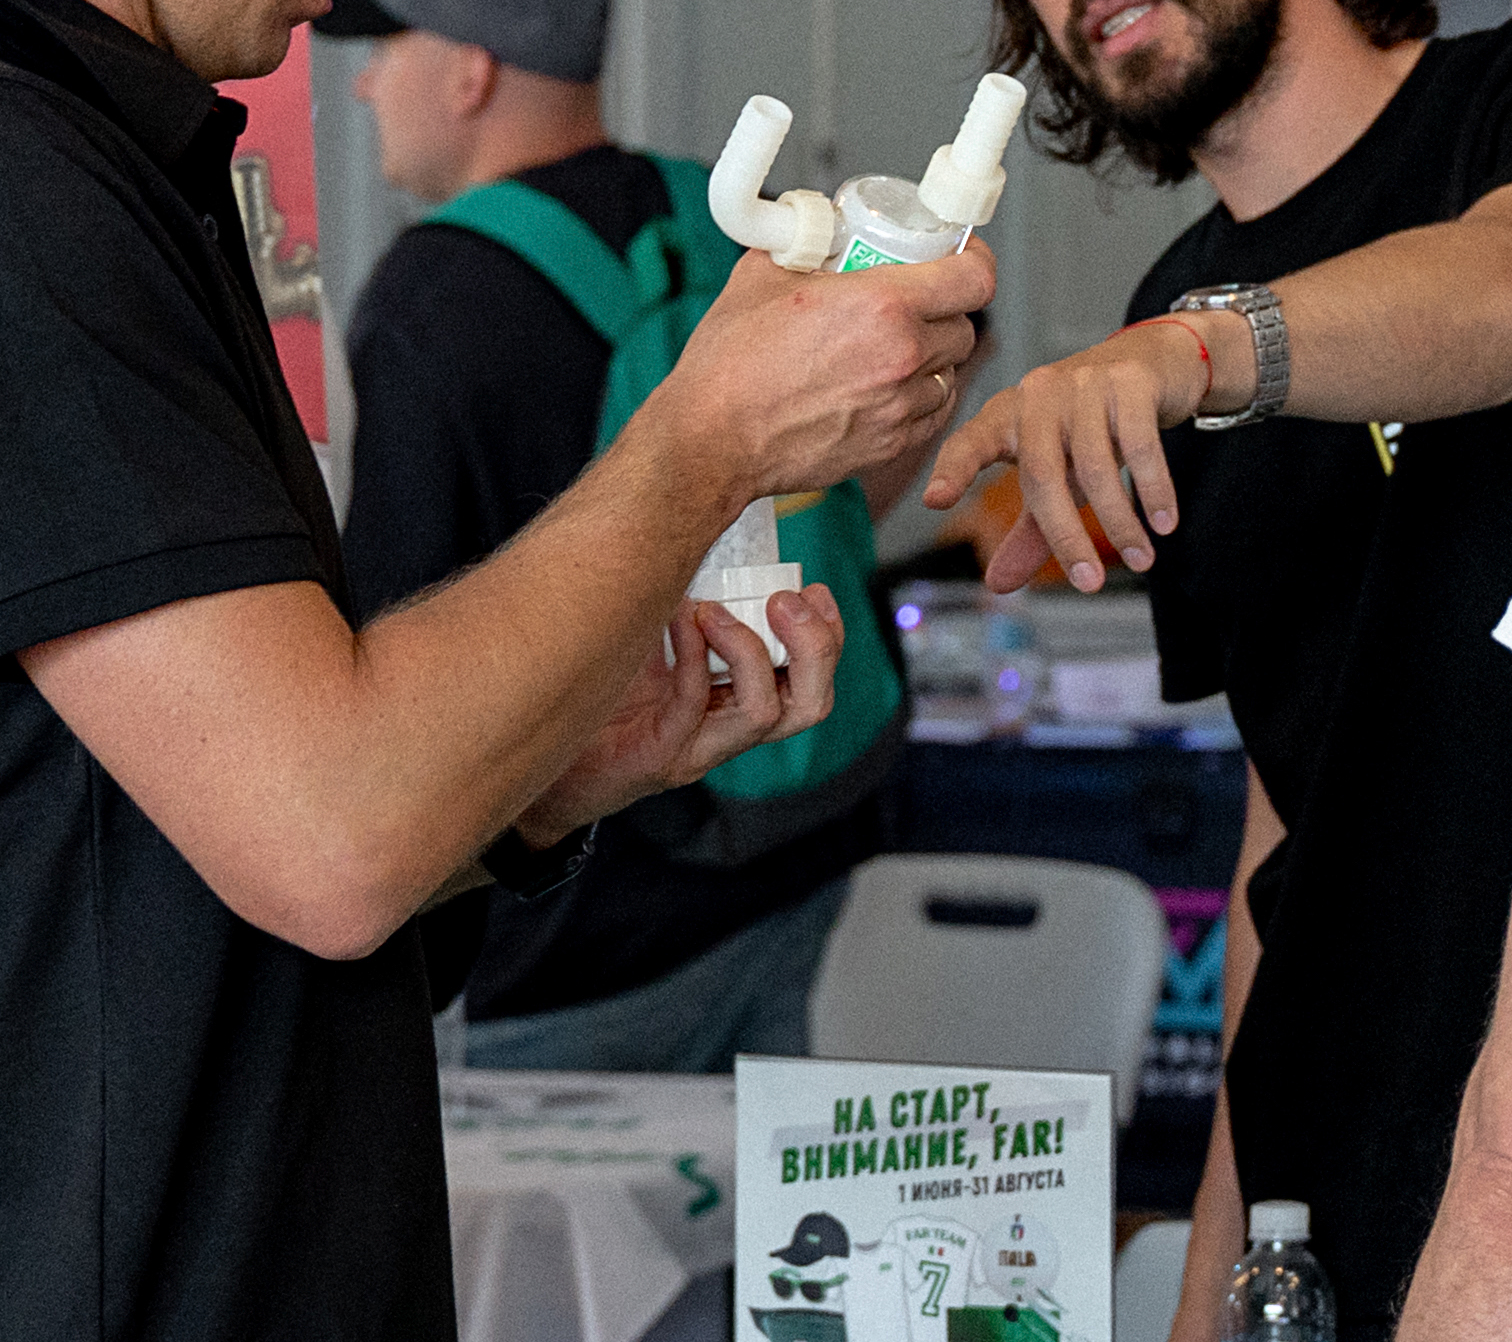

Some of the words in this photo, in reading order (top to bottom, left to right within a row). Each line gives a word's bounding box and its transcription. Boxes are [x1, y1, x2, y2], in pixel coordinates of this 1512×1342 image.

[834, 1095, 876, 1135] НА
[890, 1082, 1000, 1128] СТАРТ,
[781, 1128, 978, 1184] ВНИМАНИЕ,
[993, 1117, 1065, 1161] FAR!
[994, 1168, 1065, 1194] АВГУСТА
[919, 1259, 951, 1317] 7
